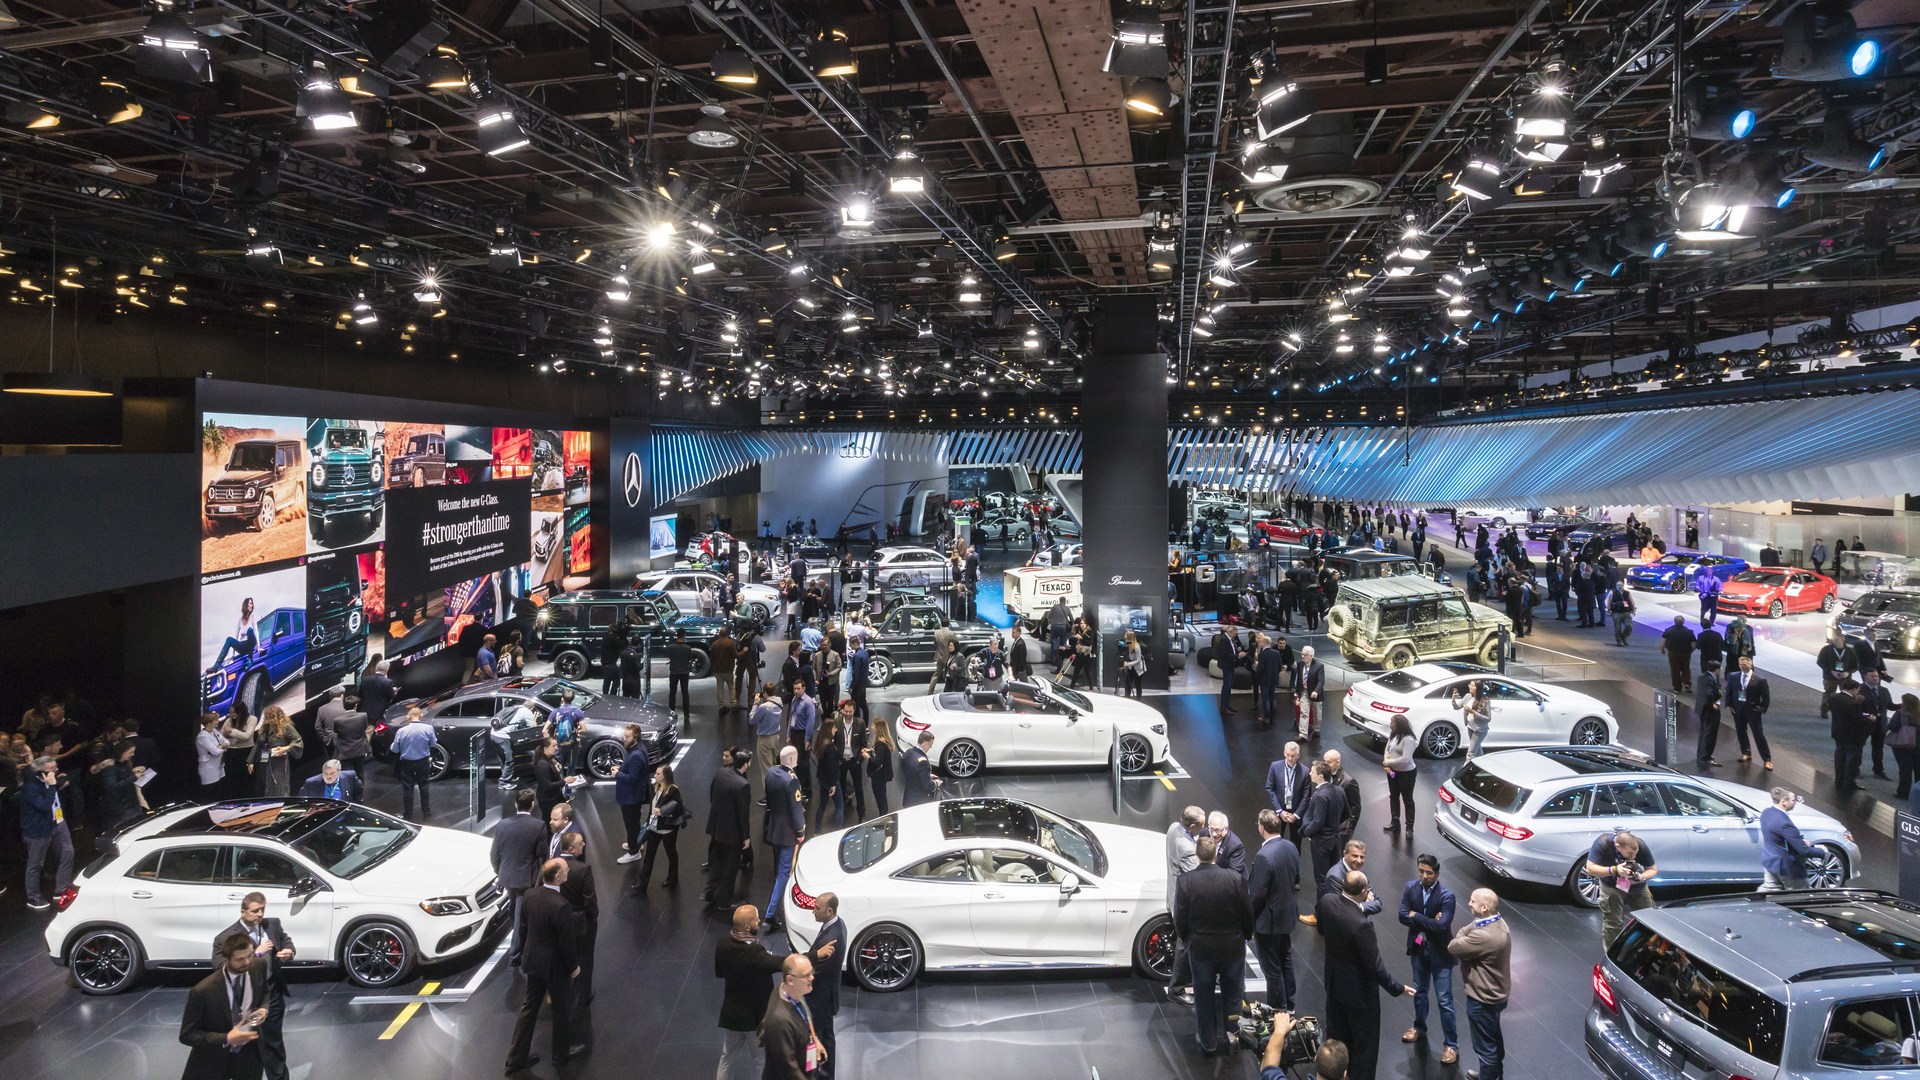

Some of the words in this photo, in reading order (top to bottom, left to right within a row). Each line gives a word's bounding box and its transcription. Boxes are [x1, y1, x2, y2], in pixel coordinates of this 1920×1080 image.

[438, 499, 461, 512] Welcome
[462, 497, 470, 508] the
[471, 498, 480, 507] new
[481, 494, 499, 506] G-Class.
[422, 512, 510, 546] #strongerthantime
[1041, 583, 1071, 592] TEXACO
[1901, 821, 1920, 836] GLS
